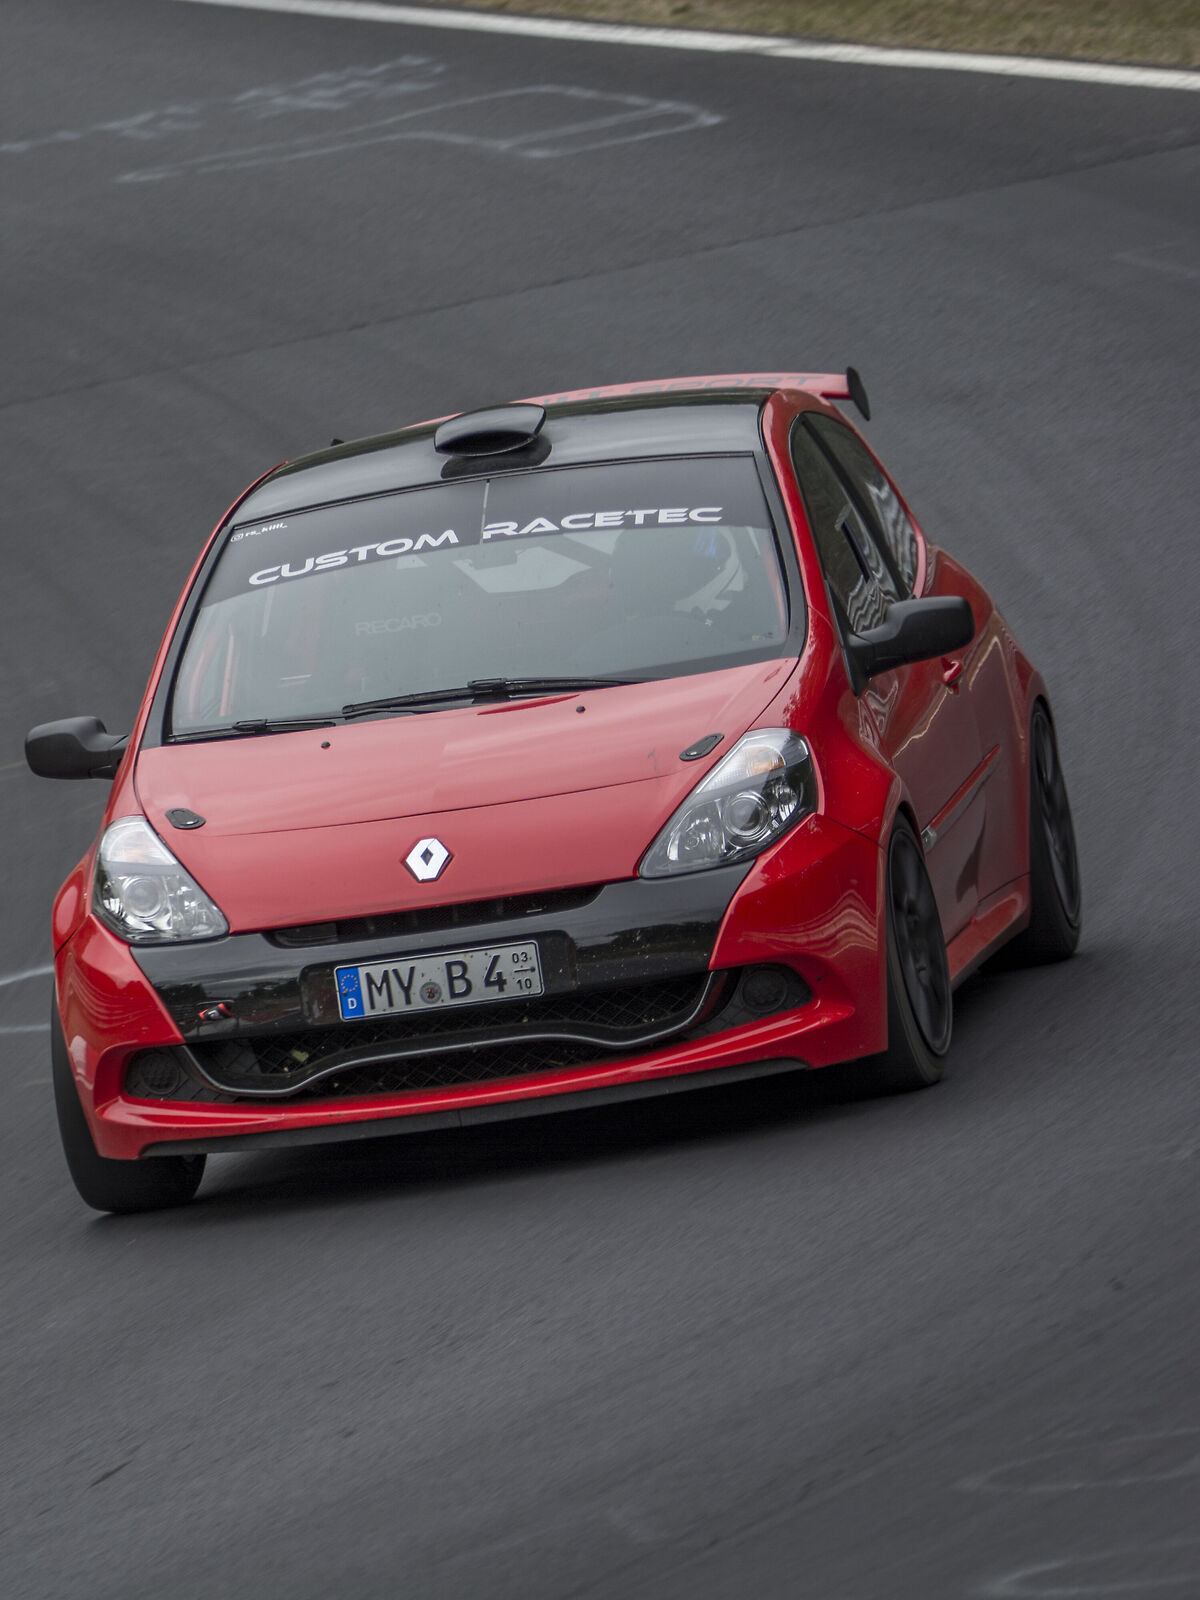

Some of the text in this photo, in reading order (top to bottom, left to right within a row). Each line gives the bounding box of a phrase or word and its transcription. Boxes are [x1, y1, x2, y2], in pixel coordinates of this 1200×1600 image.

[248, 507, 723, 586] CUSTOM RACETEC
[354, 612, 442, 636] RECARO
[511, 952, 529, 963] 03
[347, 954, 507, 1010] D MY B 4
[515, 978, 532, 990] 10
